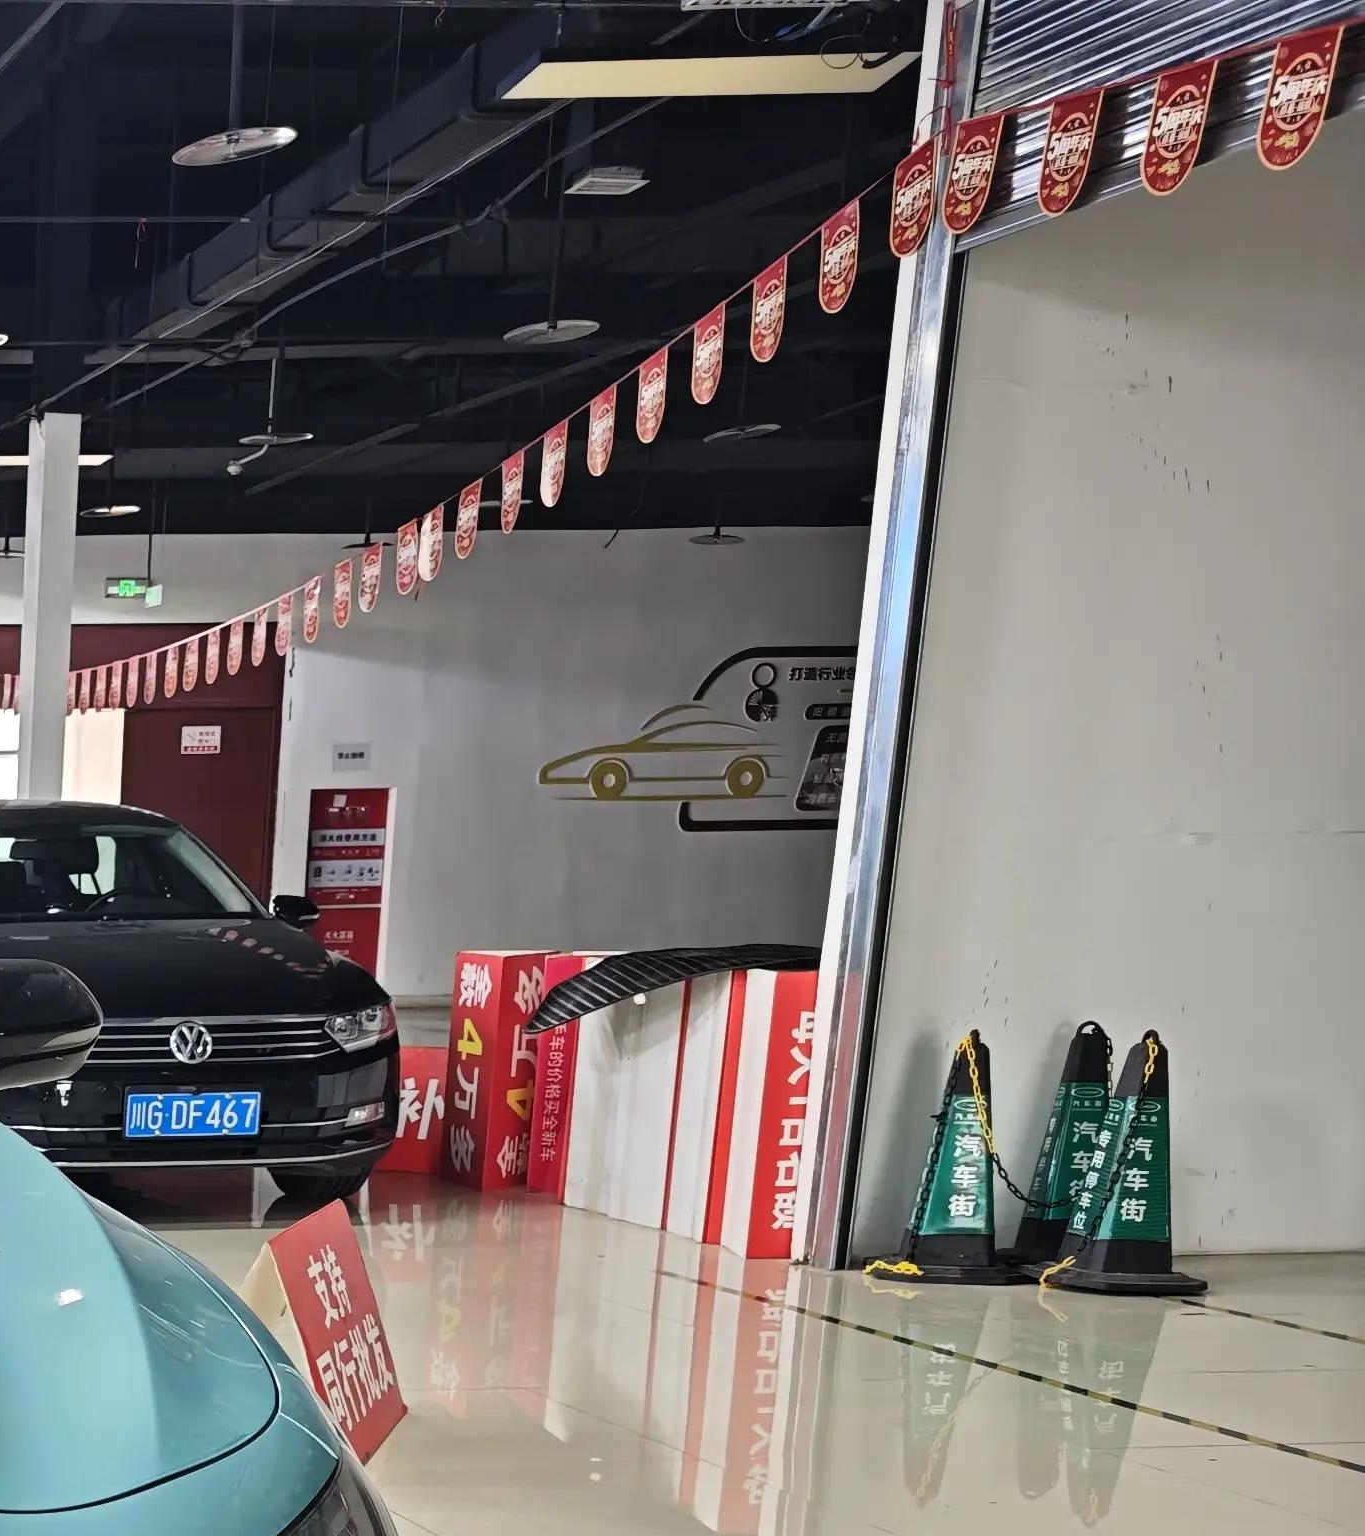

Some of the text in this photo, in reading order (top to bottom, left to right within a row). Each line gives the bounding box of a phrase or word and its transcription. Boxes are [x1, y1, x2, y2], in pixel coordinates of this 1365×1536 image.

[948, 1134, 983, 1217] 汽车街
[1120, 1136, 1153, 1222] 汽车街
[306, 1244, 352, 1330] 支持
[315, 1313, 397, 1432] 同行批发
